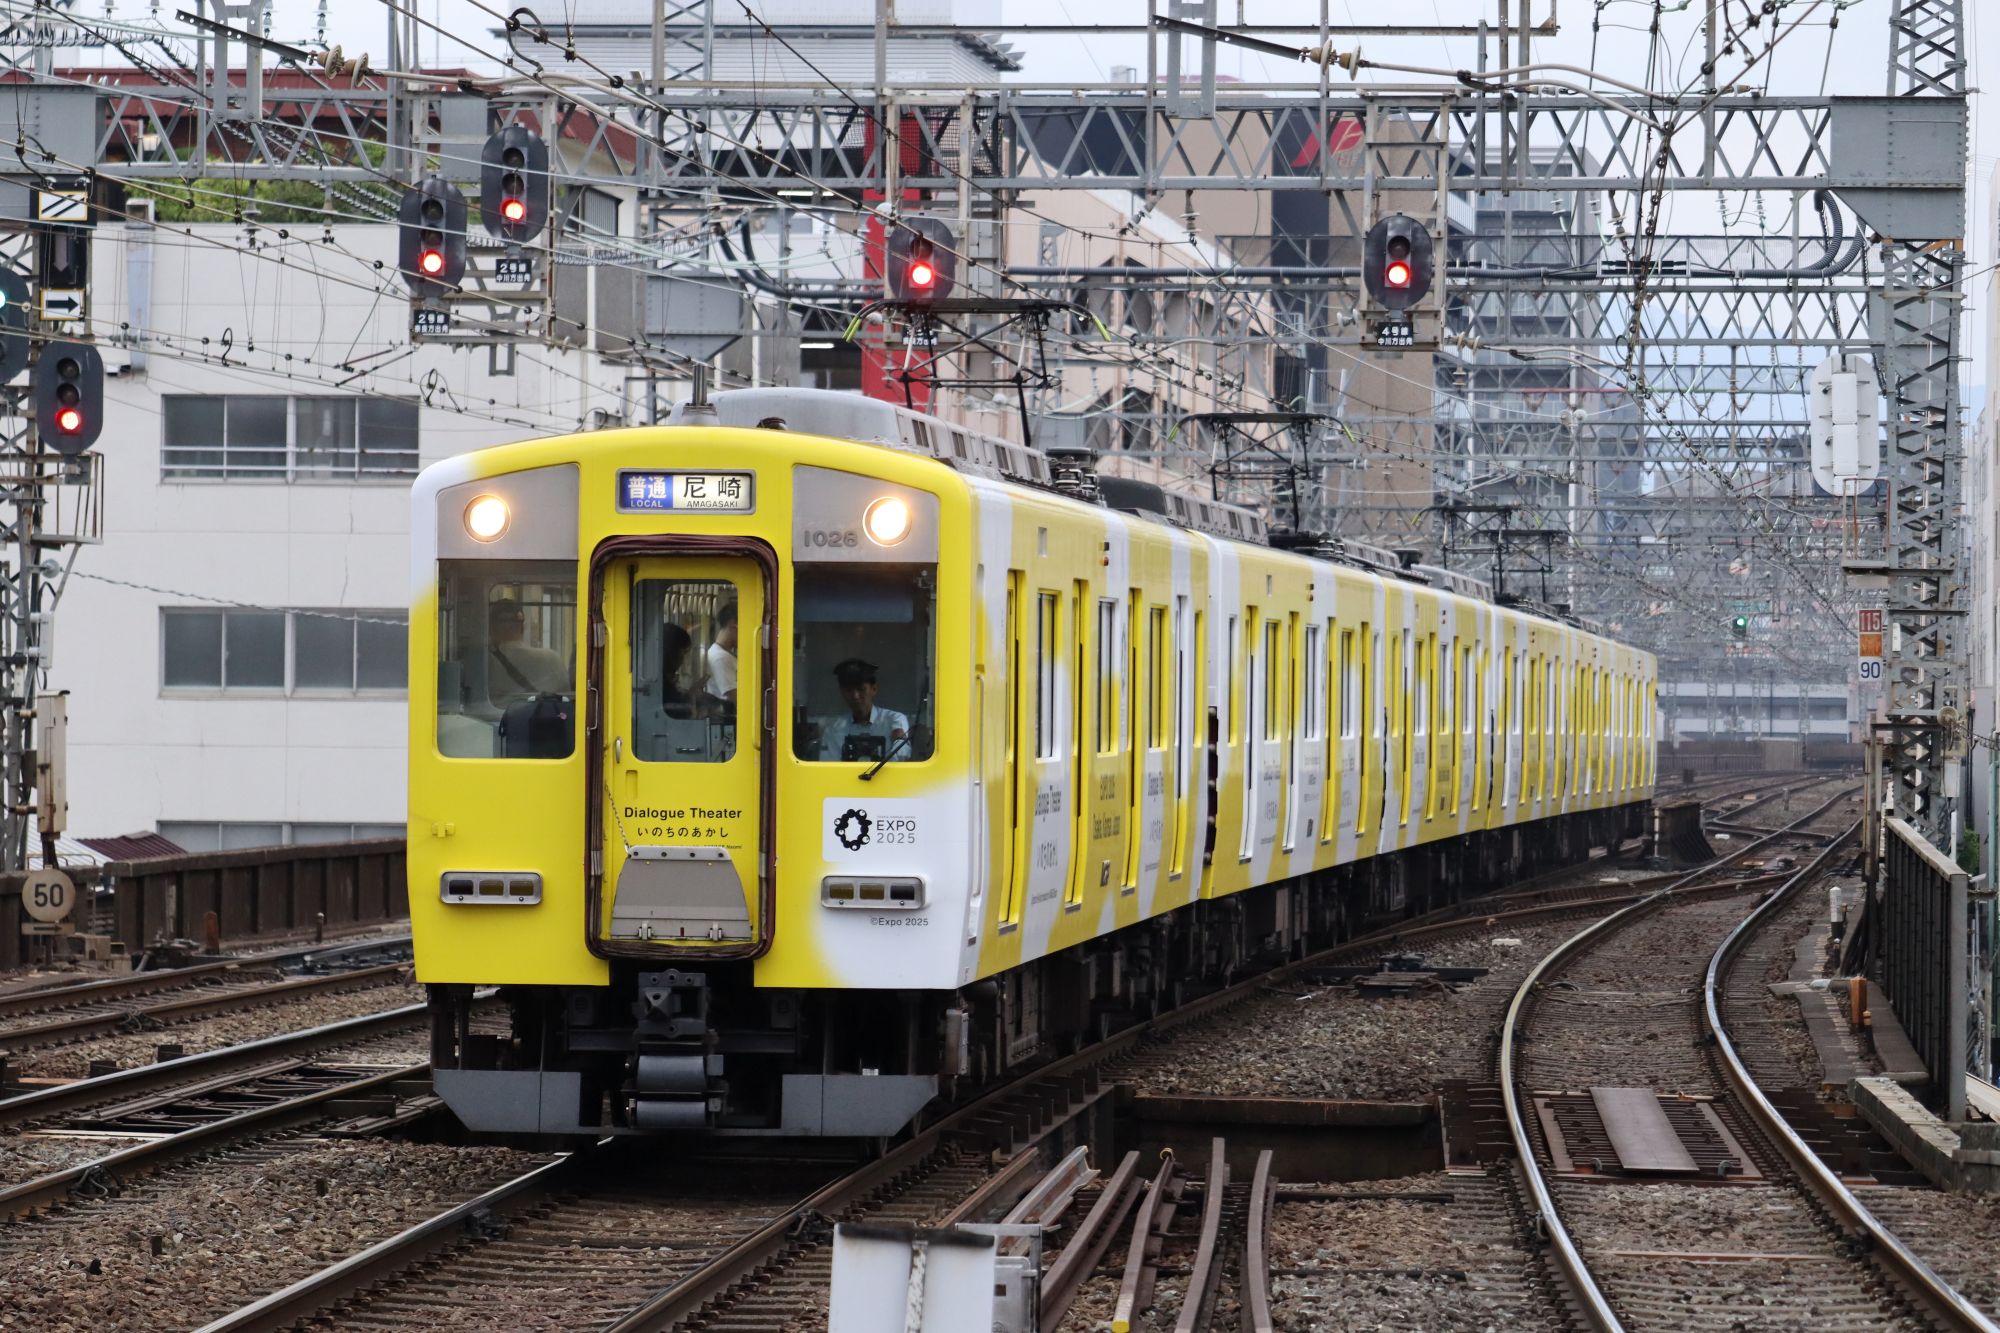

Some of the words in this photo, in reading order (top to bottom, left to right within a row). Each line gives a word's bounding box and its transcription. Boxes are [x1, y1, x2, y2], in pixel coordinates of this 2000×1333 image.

[628, 476, 667, 499] 普通
[683, 476, 741, 499] 尼崎
[630, 500, 663, 508] LOCAL
[686, 500, 738, 508] AMAGASAKI
[804, 530, 858, 548] 1026
[1861, 612, 1880, 631] 115
[1860, 661, 1881, 679] 90
[624, 807, 685, 820] Dialogue
[690, 807, 742, 819] Theater
[637, 826, 729, 838] いのちのあかし
[877, 820, 916, 831] EXPO
[877, 832, 916, 844] 2025
[35, 883, 64, 907] 50
[905, 917, 929, 926] 2025
